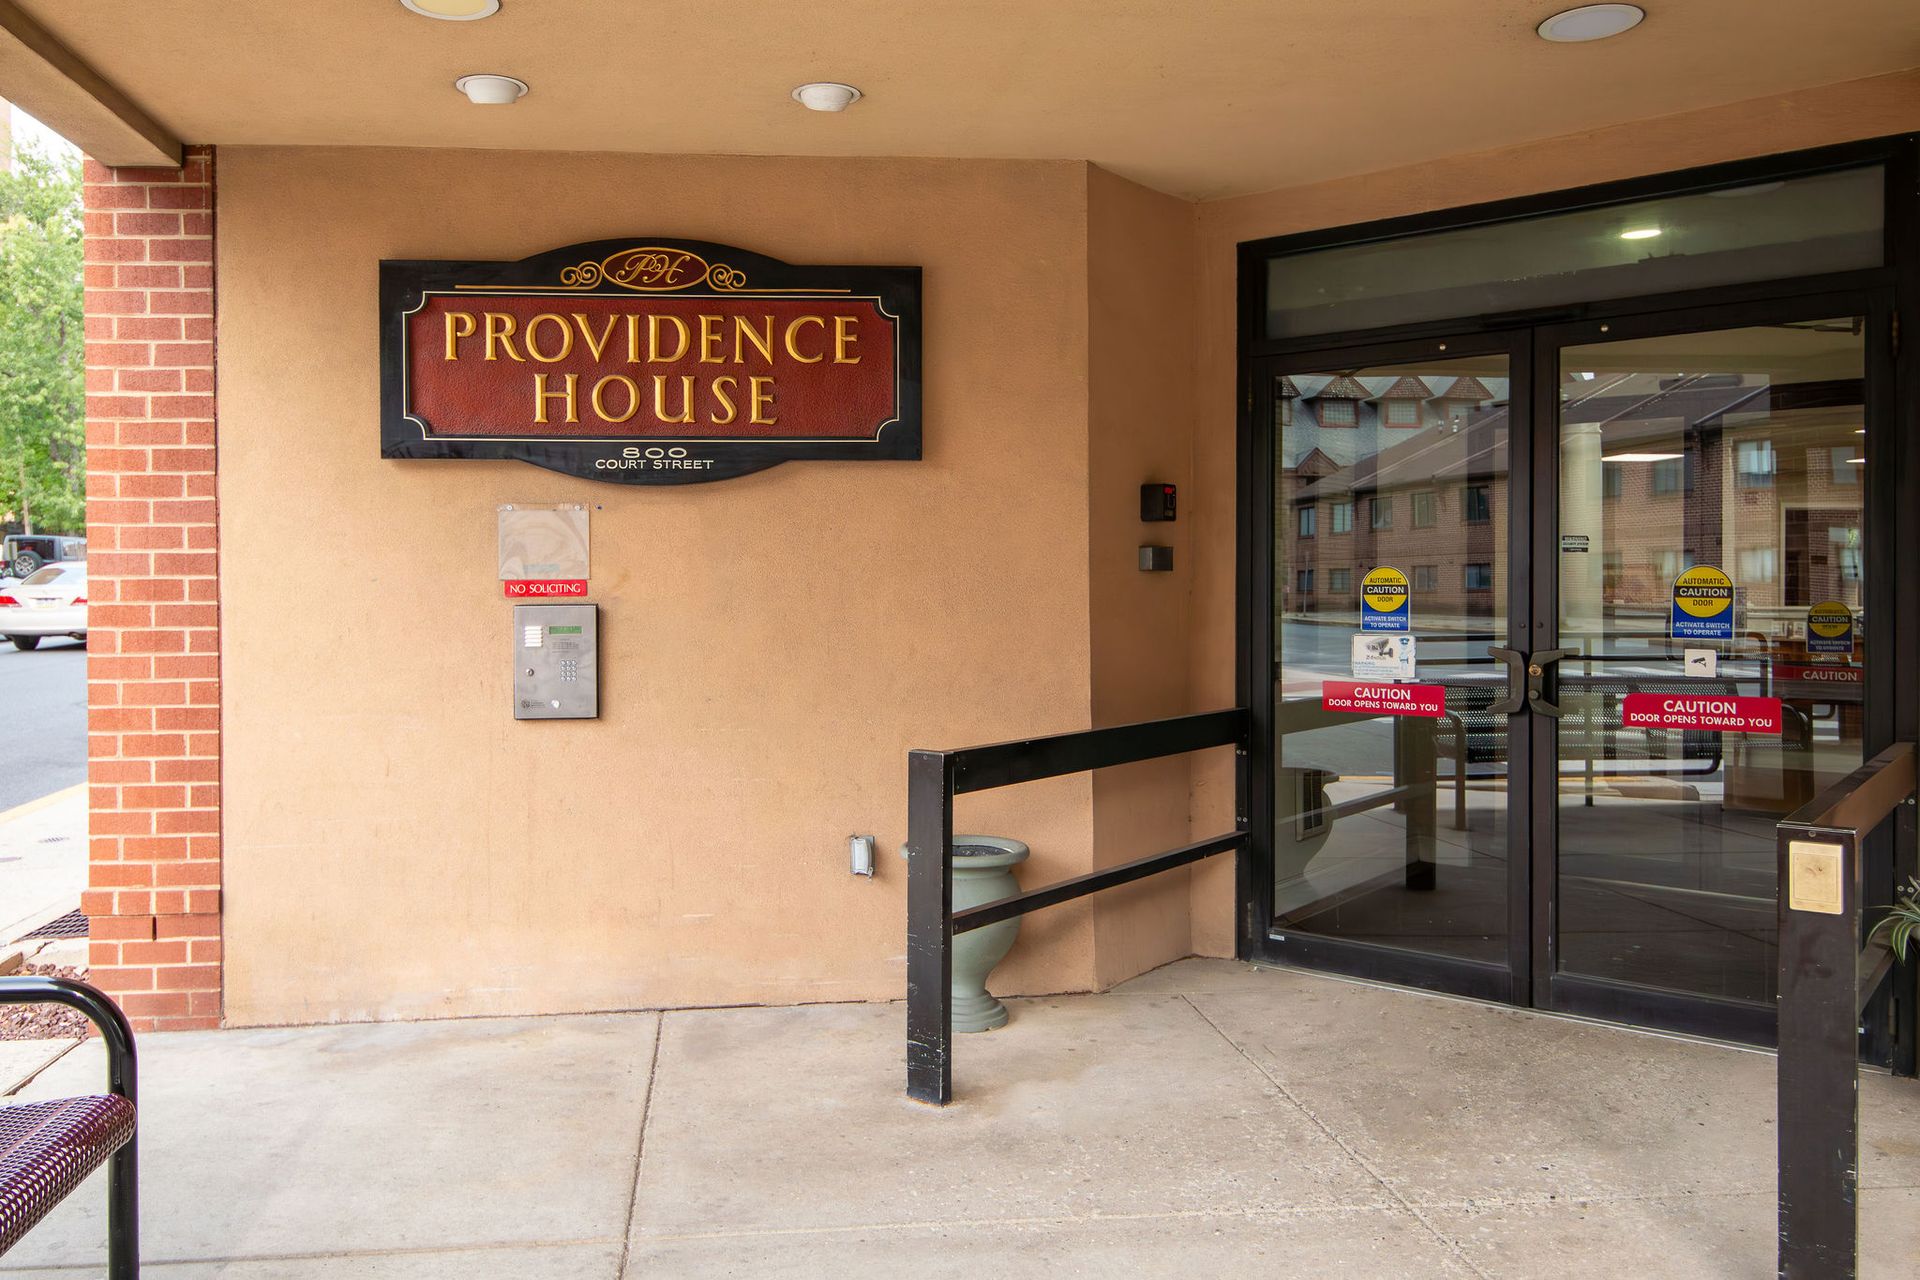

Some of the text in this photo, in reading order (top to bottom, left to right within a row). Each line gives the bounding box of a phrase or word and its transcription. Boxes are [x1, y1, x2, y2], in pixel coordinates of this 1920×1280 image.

[444, 311, 863, 364] PROVIDENCE
[534, 373, 779, 425] HOUSE
[622, 447, 688, 459] 800
[595, 459, 714, 470] COURT STREET
[1682, 577, 1725, 585] AUTOMATIC
[509, 583, 581, 594] NO SOLICITING
[1366, 586, 1405, 594] CAUTION
[1679, 587, 1728, 597] CAUTION
[1692, 599, 1714, 607] DOOR
[1675, 621, 1705, 629] ACTIVATE
[1802, 671, 1858, 681] CAUTION
[1354, 687, 1411, 700] CAUTION
[1328, 698, 1438, 712] DOOR OPENS TOWARD YOU
[1663, 700, 1737, 715] CAUTION
[1630, 713, 1772, 727] DOOR OPENS TOWARD YOU
